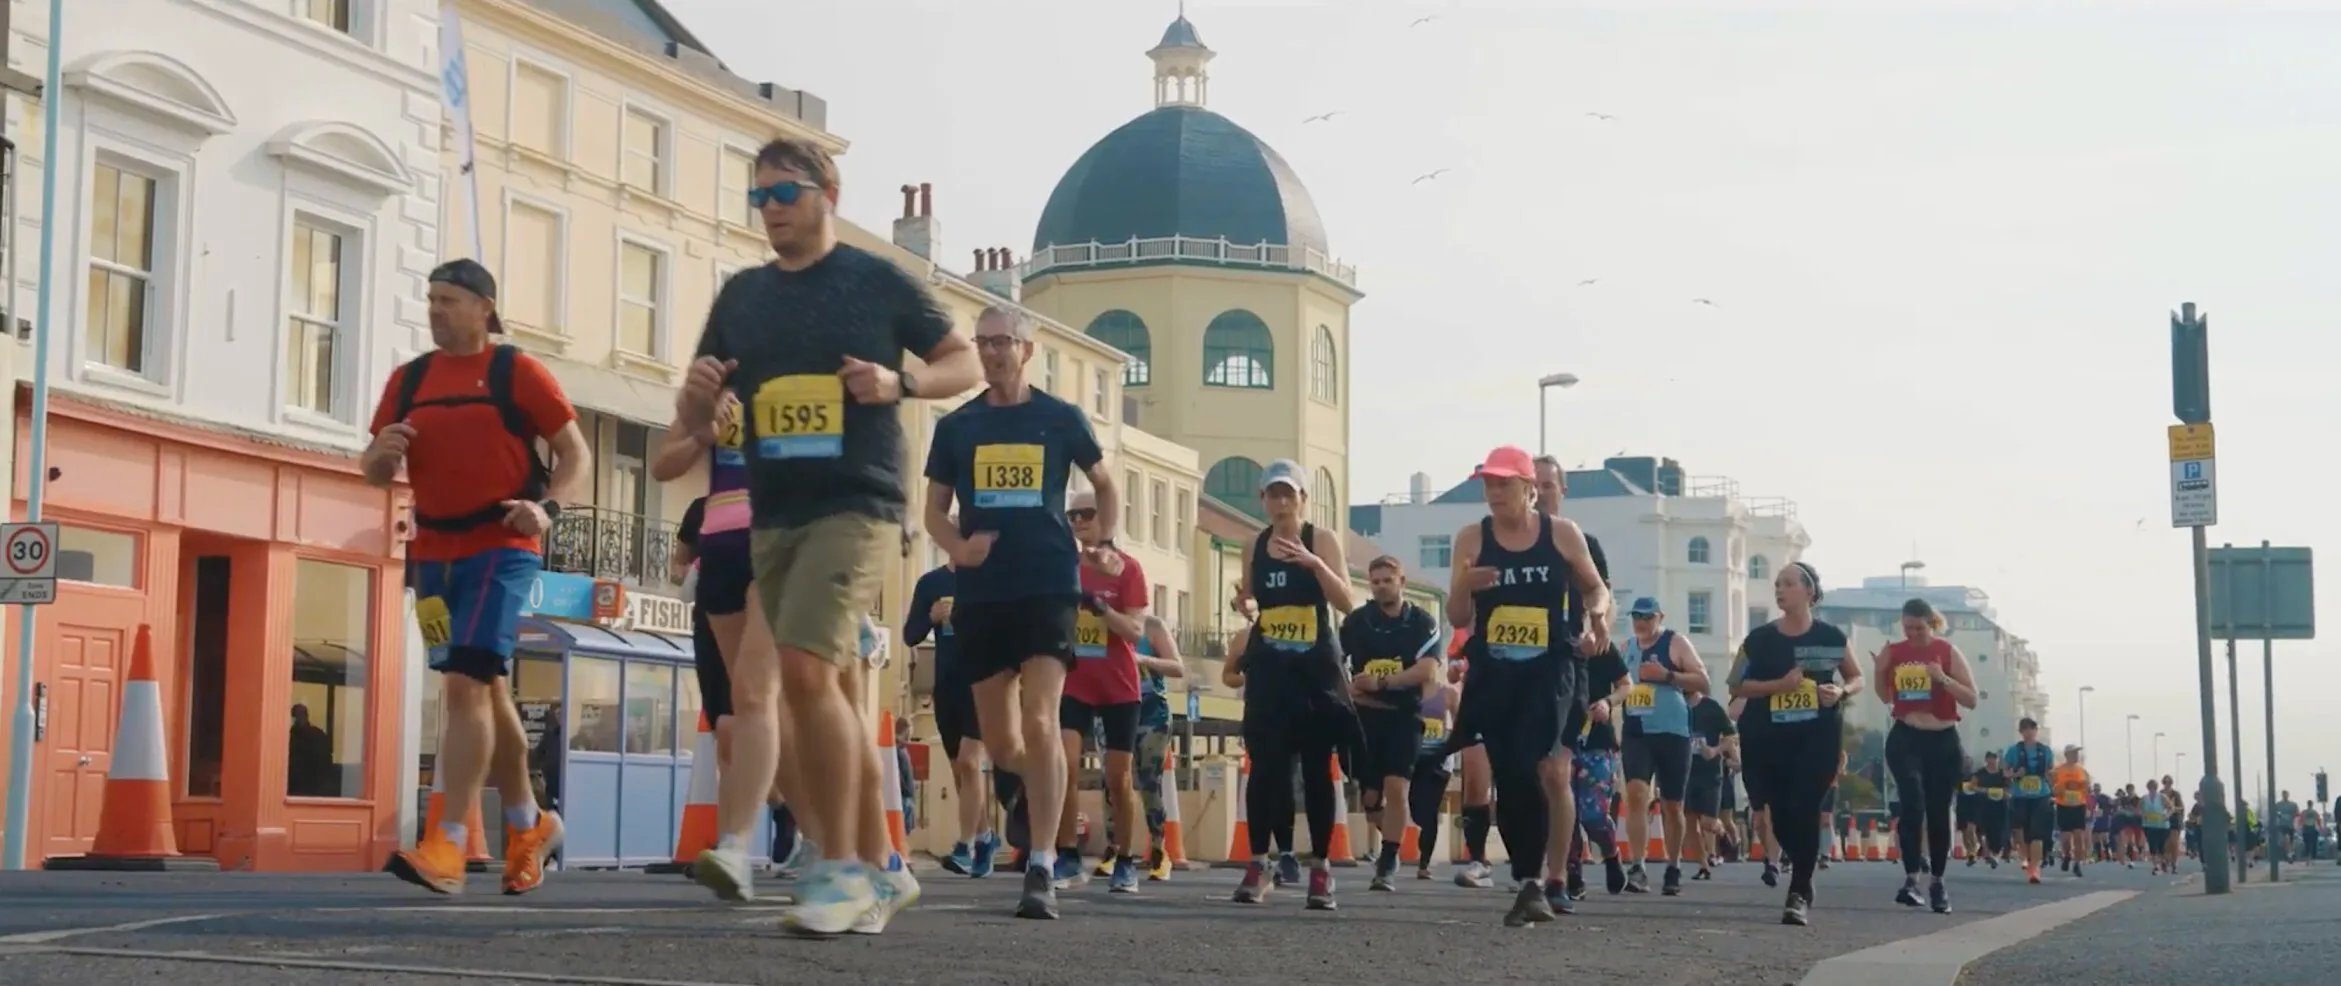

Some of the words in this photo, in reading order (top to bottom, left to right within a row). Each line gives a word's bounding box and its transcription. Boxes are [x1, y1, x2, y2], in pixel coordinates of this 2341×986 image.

[769, 404, 828, 433] 1595
[986, 465, 1034, 488] 1338
[13, 540, 43, 560] 30
[1265, 570, 1288, 588] JO
[1489, 566, 1549, 586] ATY
[22, 591, 48, 599] ENDS
[639, 598, 694, 629] FISHI
[1495, 624, 1539, 645] 2324
[1900, 676, 1926, 689] 1957
[1777, 693, 1812, 709] 1528
